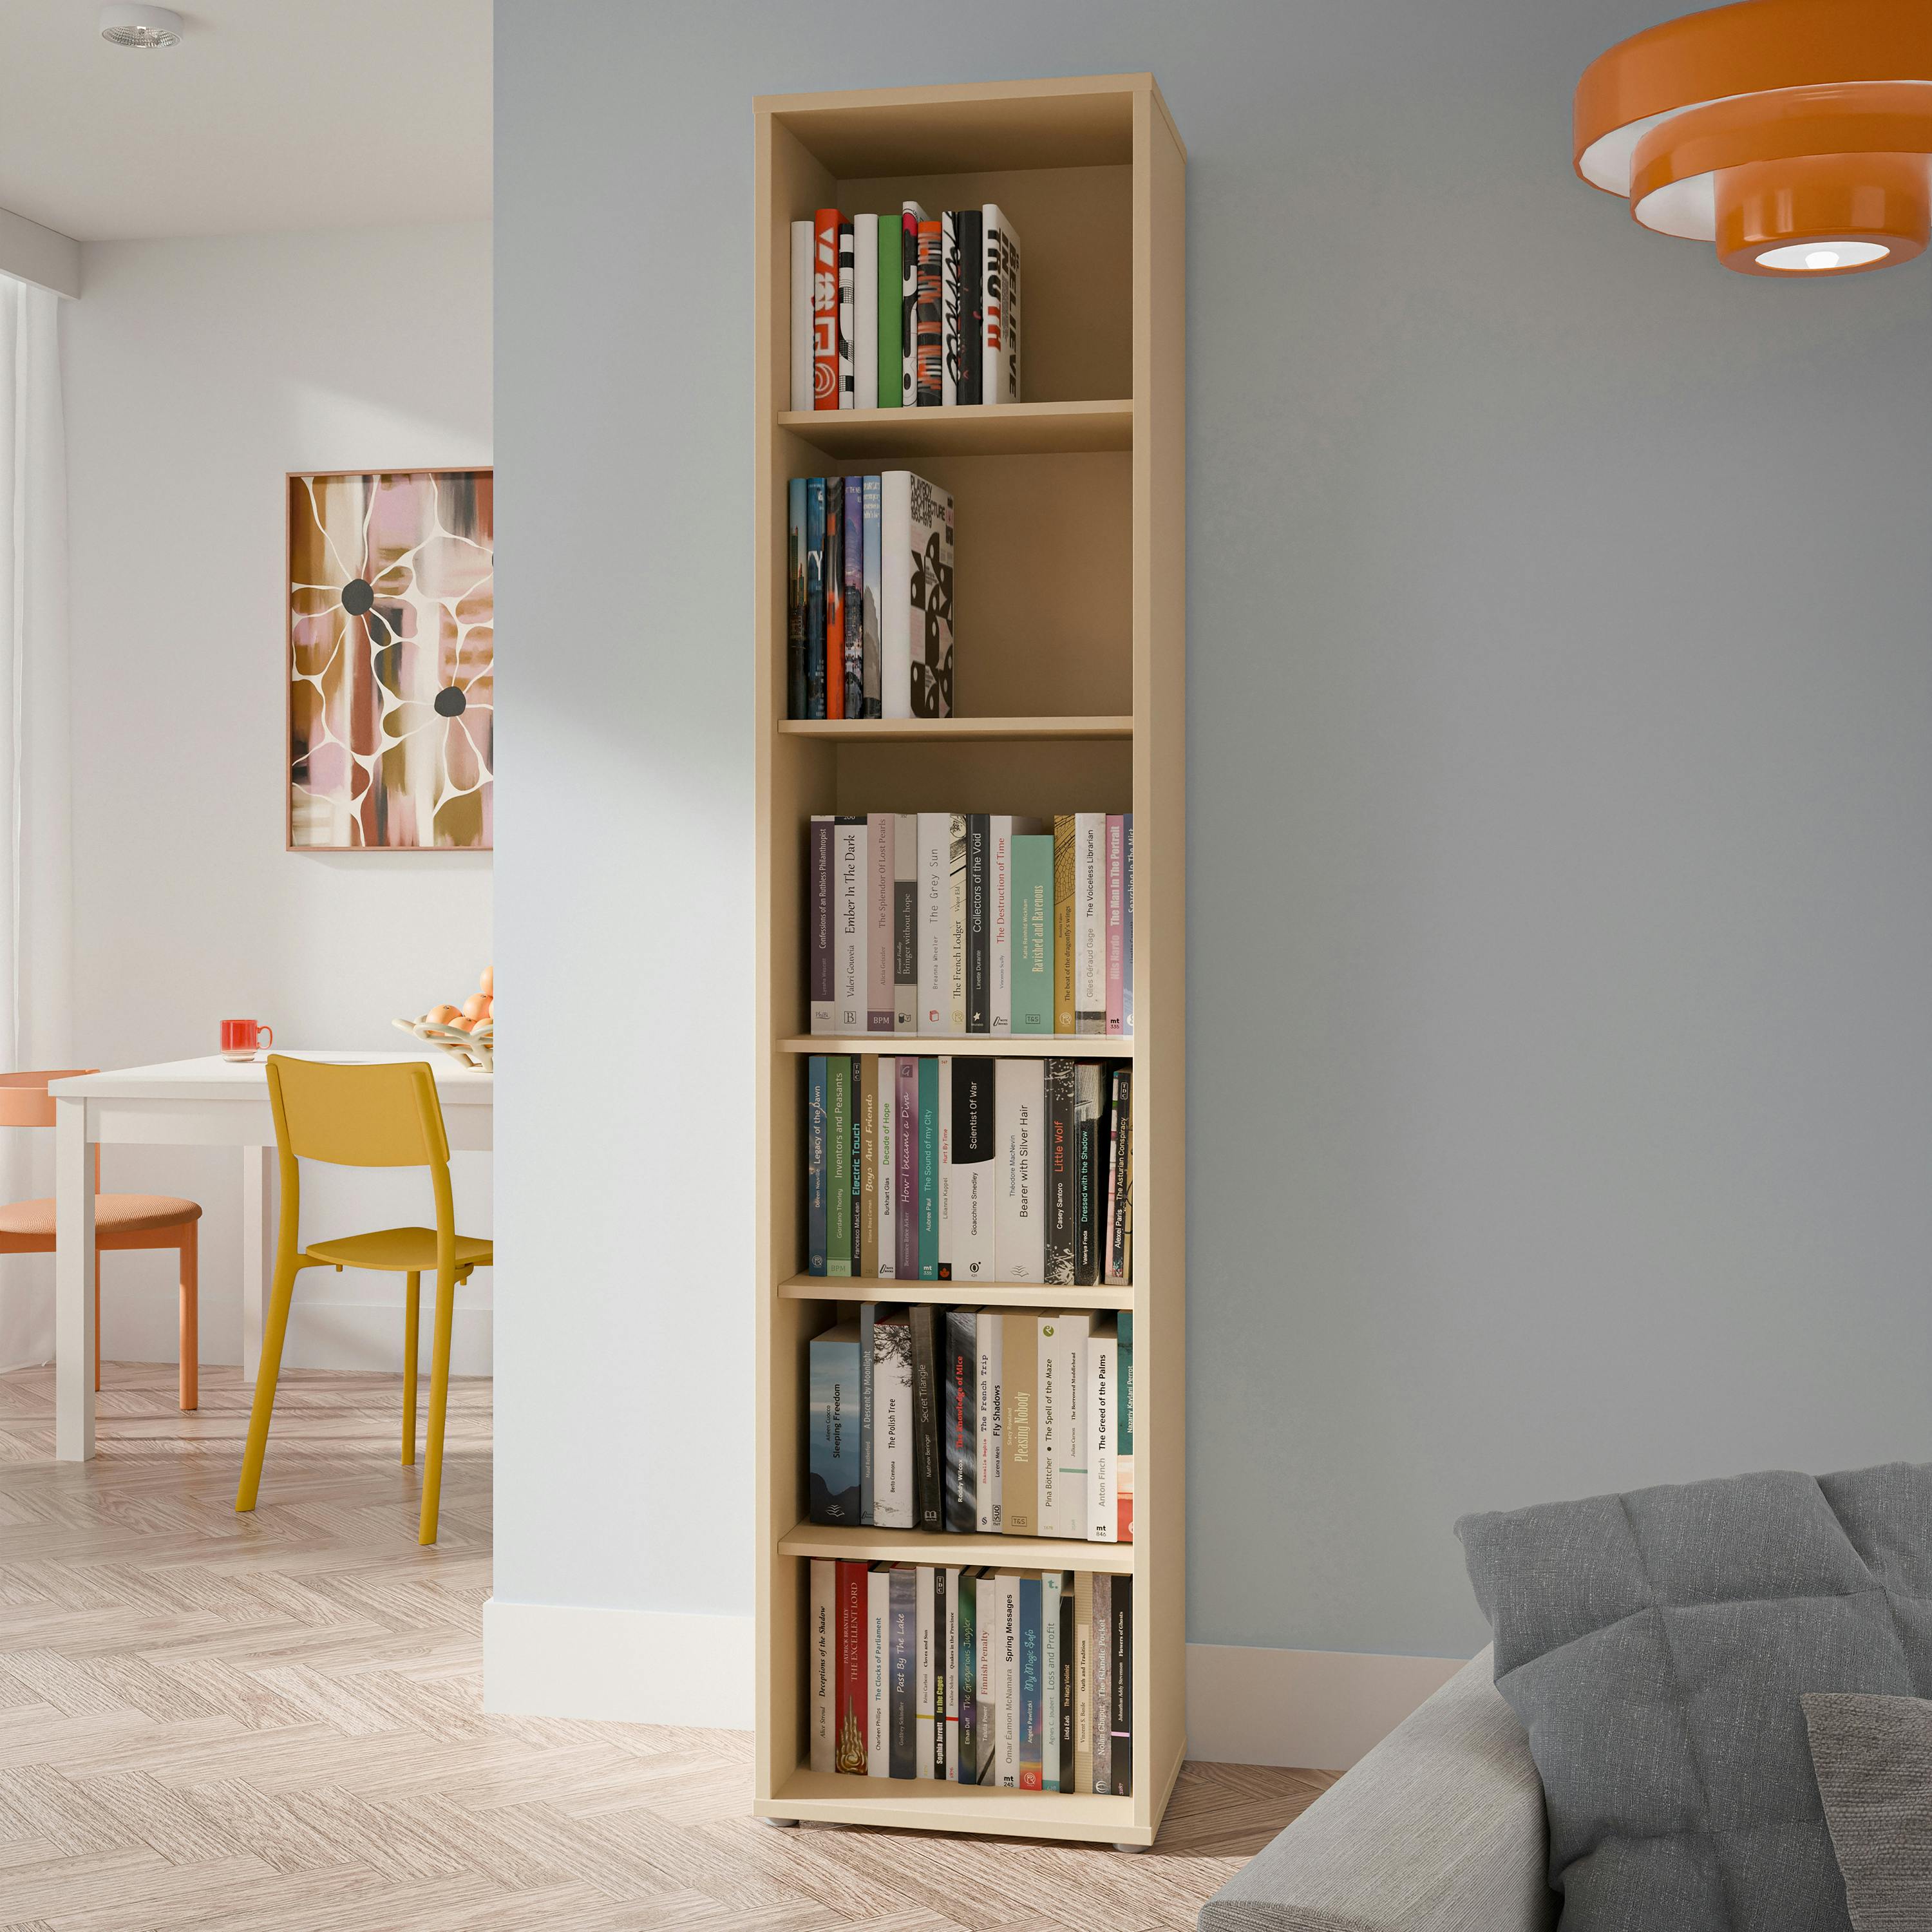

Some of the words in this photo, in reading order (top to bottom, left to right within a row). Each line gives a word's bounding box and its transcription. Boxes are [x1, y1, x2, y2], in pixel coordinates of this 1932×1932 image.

[1002, 231, 1009, 275] IN
[988, 227, 1001, 352] TRUTH
[911, 474, 932, 503] PLAYBOY
[911, 489, 945, 522] ARCHITECTURE
[819, 829, 828, 870] Philanthropist
[844, 835, 855, 860] Dark
[971, 833, 981, 854] Void
[1111, 826, 1119, 859] Portrait
[844, 864, 855, 884] The
[878, 864, 886, 873] Of
[972, 857, 981, 871] the
[996, 862, 1004, 871] of
[1111, 862, 1119, 876] The
[930, 875, 939, 898] Grey
[972, 875, 981, 884] of
[1111, 879, 1119, 887] In
[845, 887, 855, 896] In
[878, 875, 887, 911] Splendor
[903, 894, 912, 912] hope
[1032, 886, 1043, 920] Ravenous
[1111, 890, 1119, 908] Man
[844, 900, 855, 933] Ember
[972, 886, 981, 932] Collectors
[1111, 910, 1119, 925] The
[953, 921, 963, 949] Lodger
[1032, 923, 1043, 936] and
[903, 947, 912, 974] Bringer
[1032, 939, 1043, 971] Ravished
[970, 1099, 976, 1109] Of
[926, 1127, 933, 1139] my
[1054, 1121, 1063, 1142] Wolf
[866, 1168, 874, 1191] Boys
[864, 1351, 872, 1385] Moonlight
[918, 1365, 927, 1396] Triangle
[1015, 1392, 1030, 1423] Nobody
[993, 1424, 1001, 1435] Fly
[1015, 1426, 1030, 1462] Pleasing
[897, 1658, 906, 1669] By
